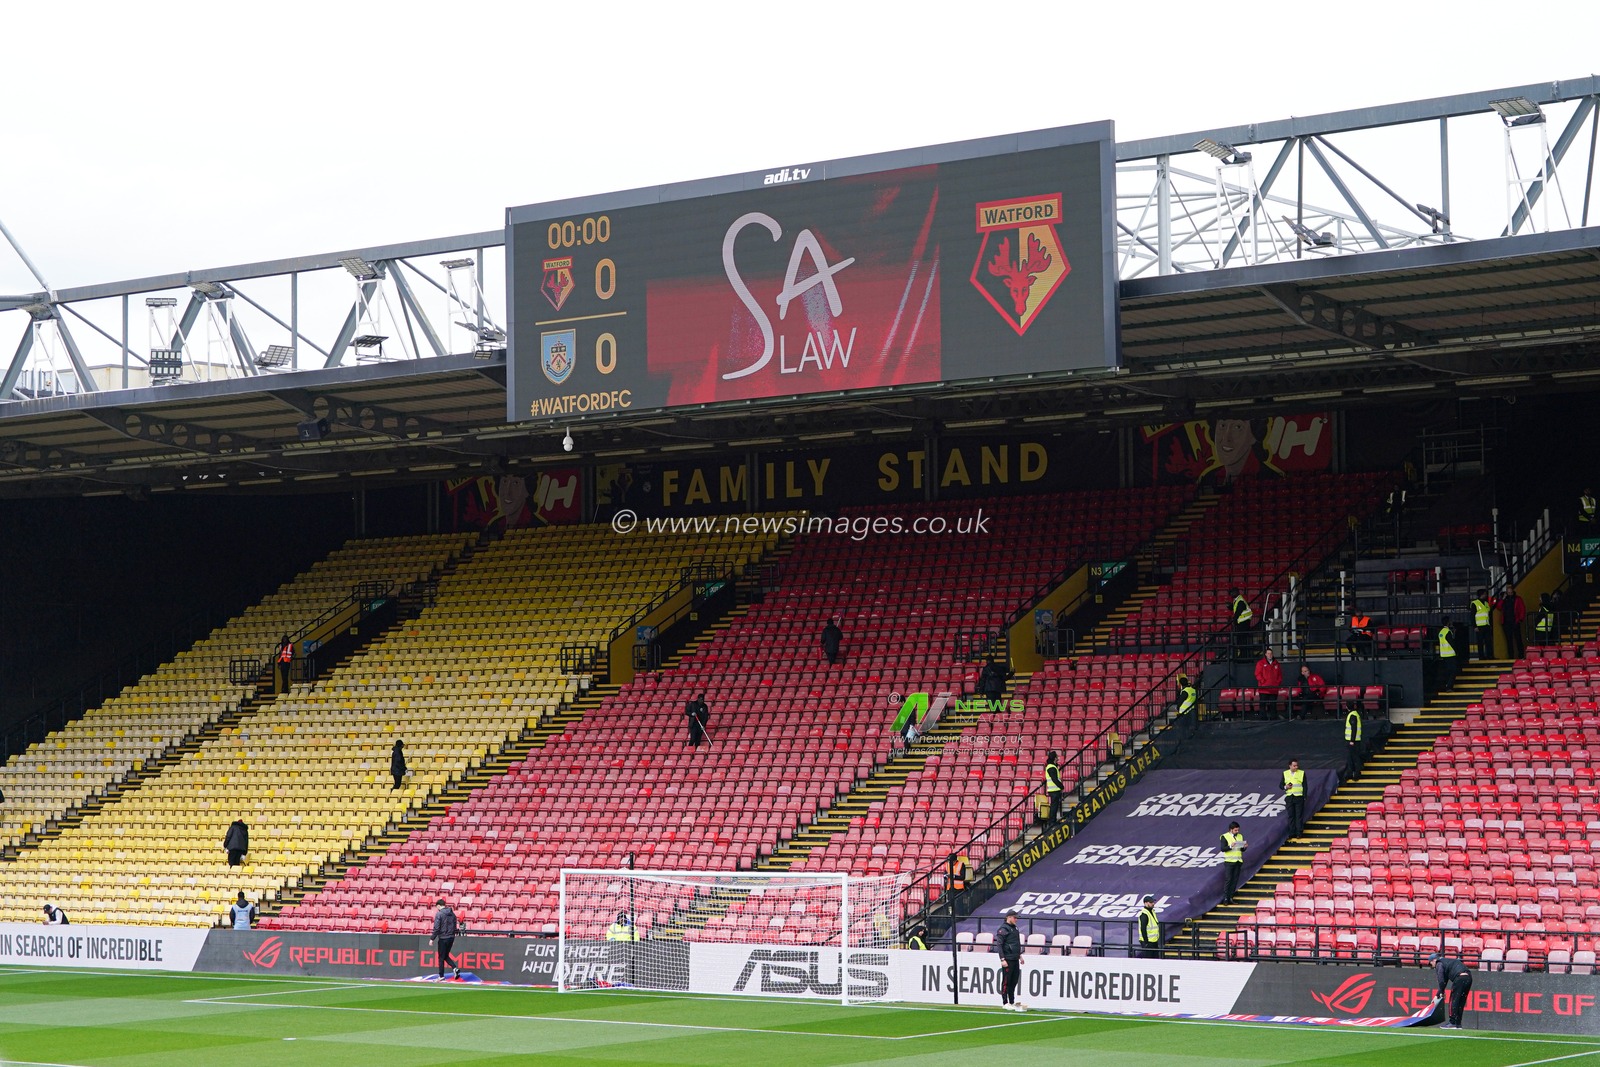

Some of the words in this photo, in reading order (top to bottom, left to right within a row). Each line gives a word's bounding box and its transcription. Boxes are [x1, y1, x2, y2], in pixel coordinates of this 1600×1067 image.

[763, 168, 811, 185] adi.tv
[984, 204, 1054, 224] WATFORD
[547, 215, 611, 250] 00:00
[545, 260, 570, 268] WATFORD
[595, 258, 616, 300] 0
[595, 332, 617, 375] 0
[779, 327, 857, 374] LAW
[530, 389, 632, 416] #WATFORDFC
[662, 457, 831, 507] FAMILY
[876, 441, 1050, 492] STAND
[1567, 543, 1581, 553] N4
[1091, 567, 1102, 576] N3
[992, 824, 1071, 891] DESIGNATED
[1076, 775, 1127, 824] SEATING
[1129, 745, 1161, 780] AREA
[1125, 804, 1286, 818] MANAGER
[1063, 855, 1225, 869] MANAGER
[0, 934, 12, 956] IN
[16, 934, 64, 958] SEARCH
[67, 936, 83, 959] OF
[86, 937, 163, 962] INCREDIBLE
[289, 946, 383, 967] REPUBLIC
[388, 950, 411, 968] OF
[524, 944, 556, 957] FOR
[521, 961, 554, 973] WHO
[732, 949, 889, 998] ASUS
[921, 964, 941, 992] IN
[1029, 969, 1055, 998] OF
[1059, 970, 1181, 1003] INCREDIBLE
[1553, 993, 1596, 1017] OF
